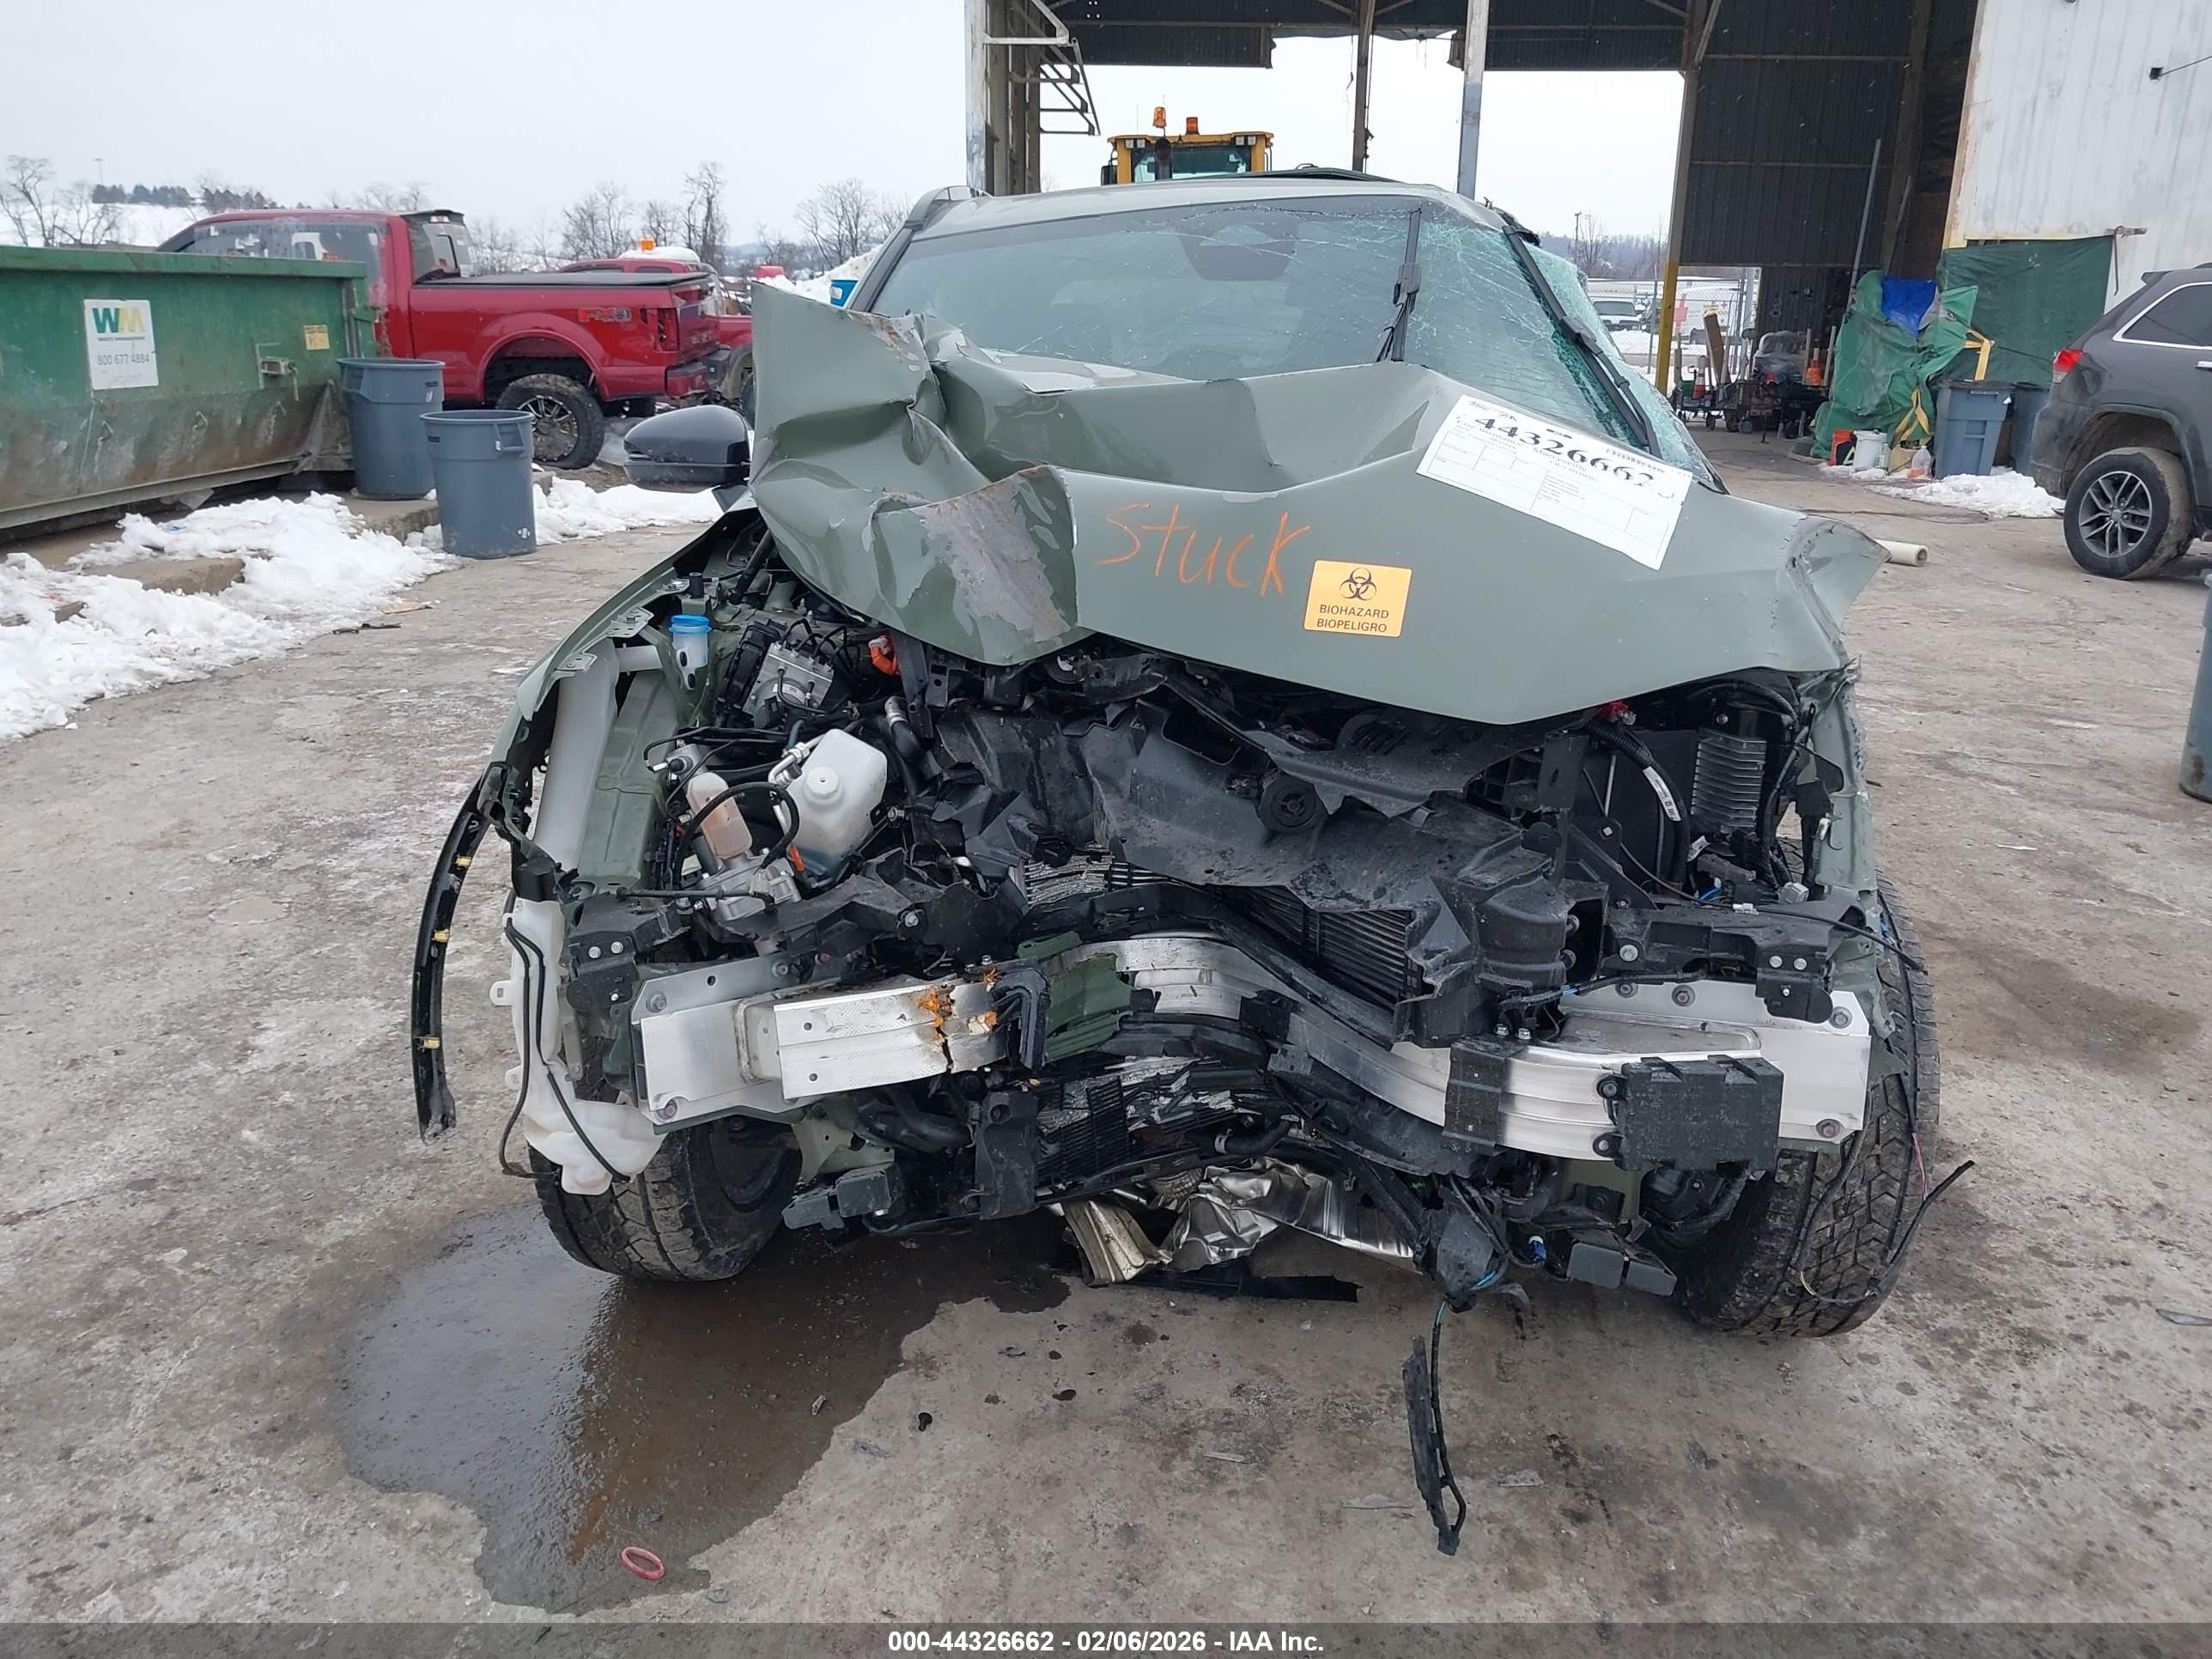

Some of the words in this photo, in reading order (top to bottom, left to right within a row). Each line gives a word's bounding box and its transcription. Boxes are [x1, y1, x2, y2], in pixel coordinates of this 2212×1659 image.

[92, 307, 144, 333] WM
[114, 353, 129, 365] 677
[1096, 502, 1311, 596] Stuck
[1319, 604, 1389, 619] BIOHAZARD
[1316, 618, 1388, 633] BIOPELIGRO
